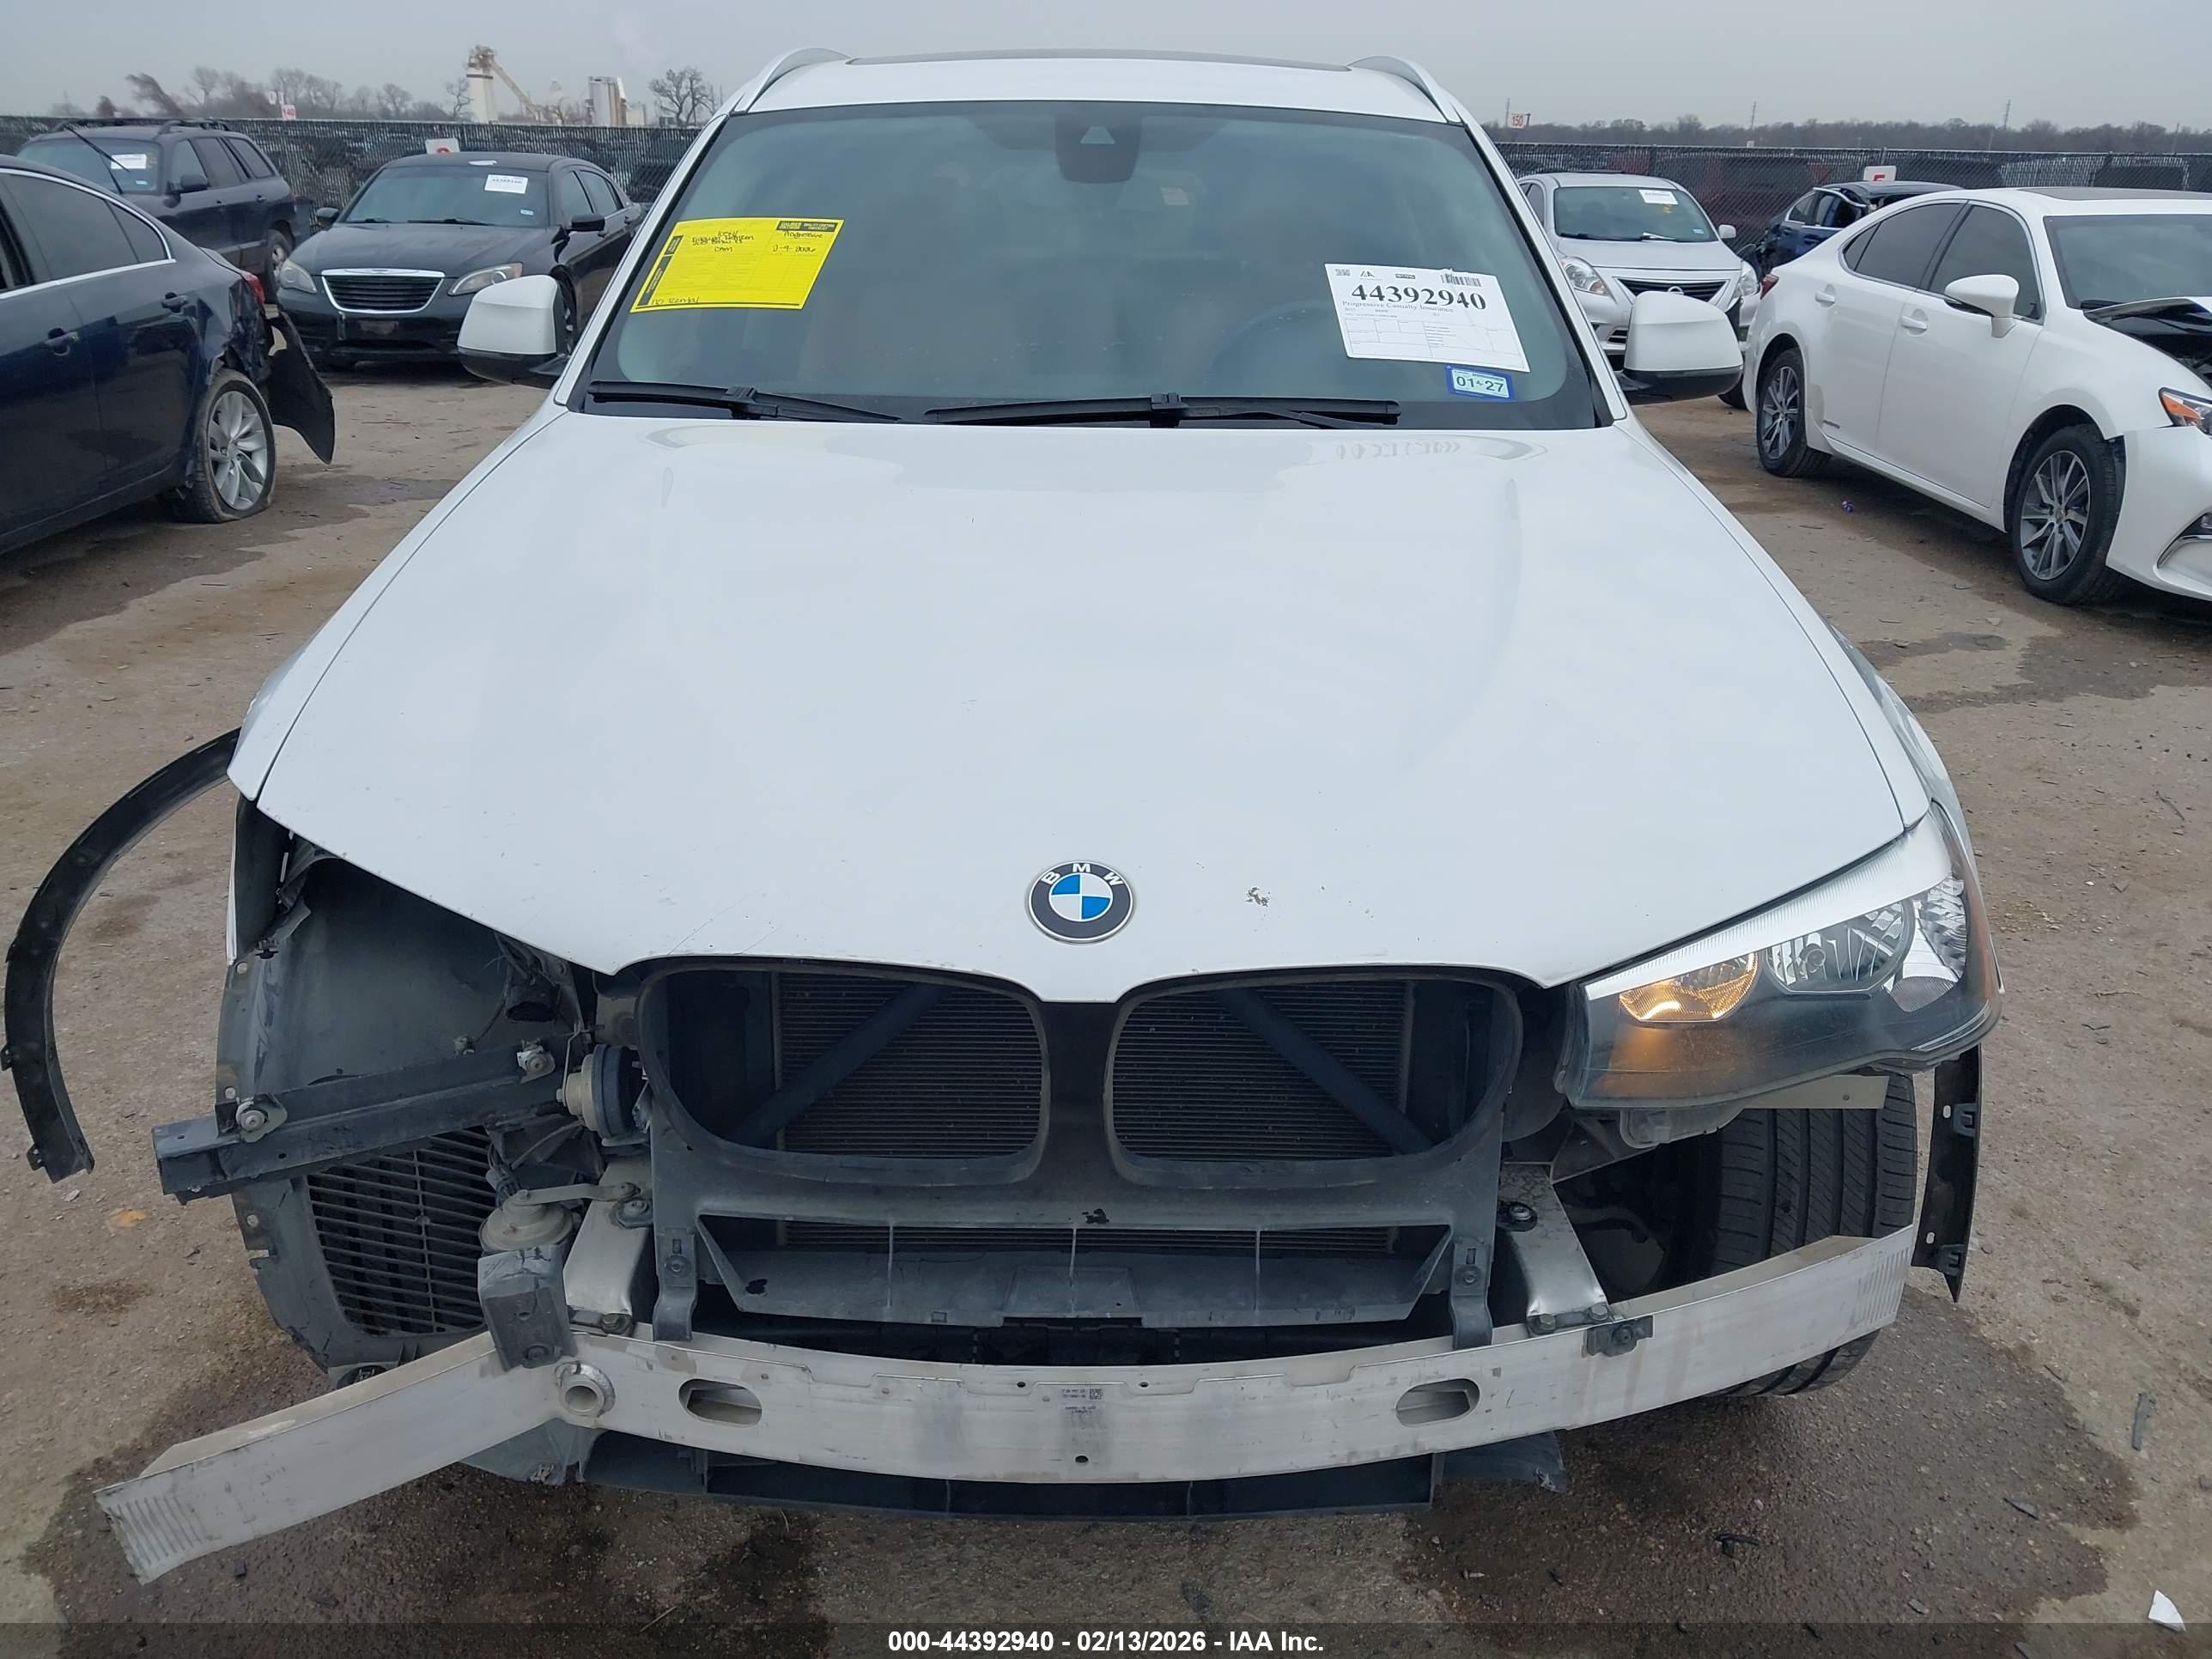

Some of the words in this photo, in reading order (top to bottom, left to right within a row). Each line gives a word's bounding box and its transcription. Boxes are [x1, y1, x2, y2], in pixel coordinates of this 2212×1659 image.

[1342, 301, 1384, 309] Progressive
[1386, 301, 1417, 311] Casualty
[1419, 303, 1454, 313] Insurance
[1352, 283, 1486, 310] 44392940
[1041, 863, 1124, 886] BMW
